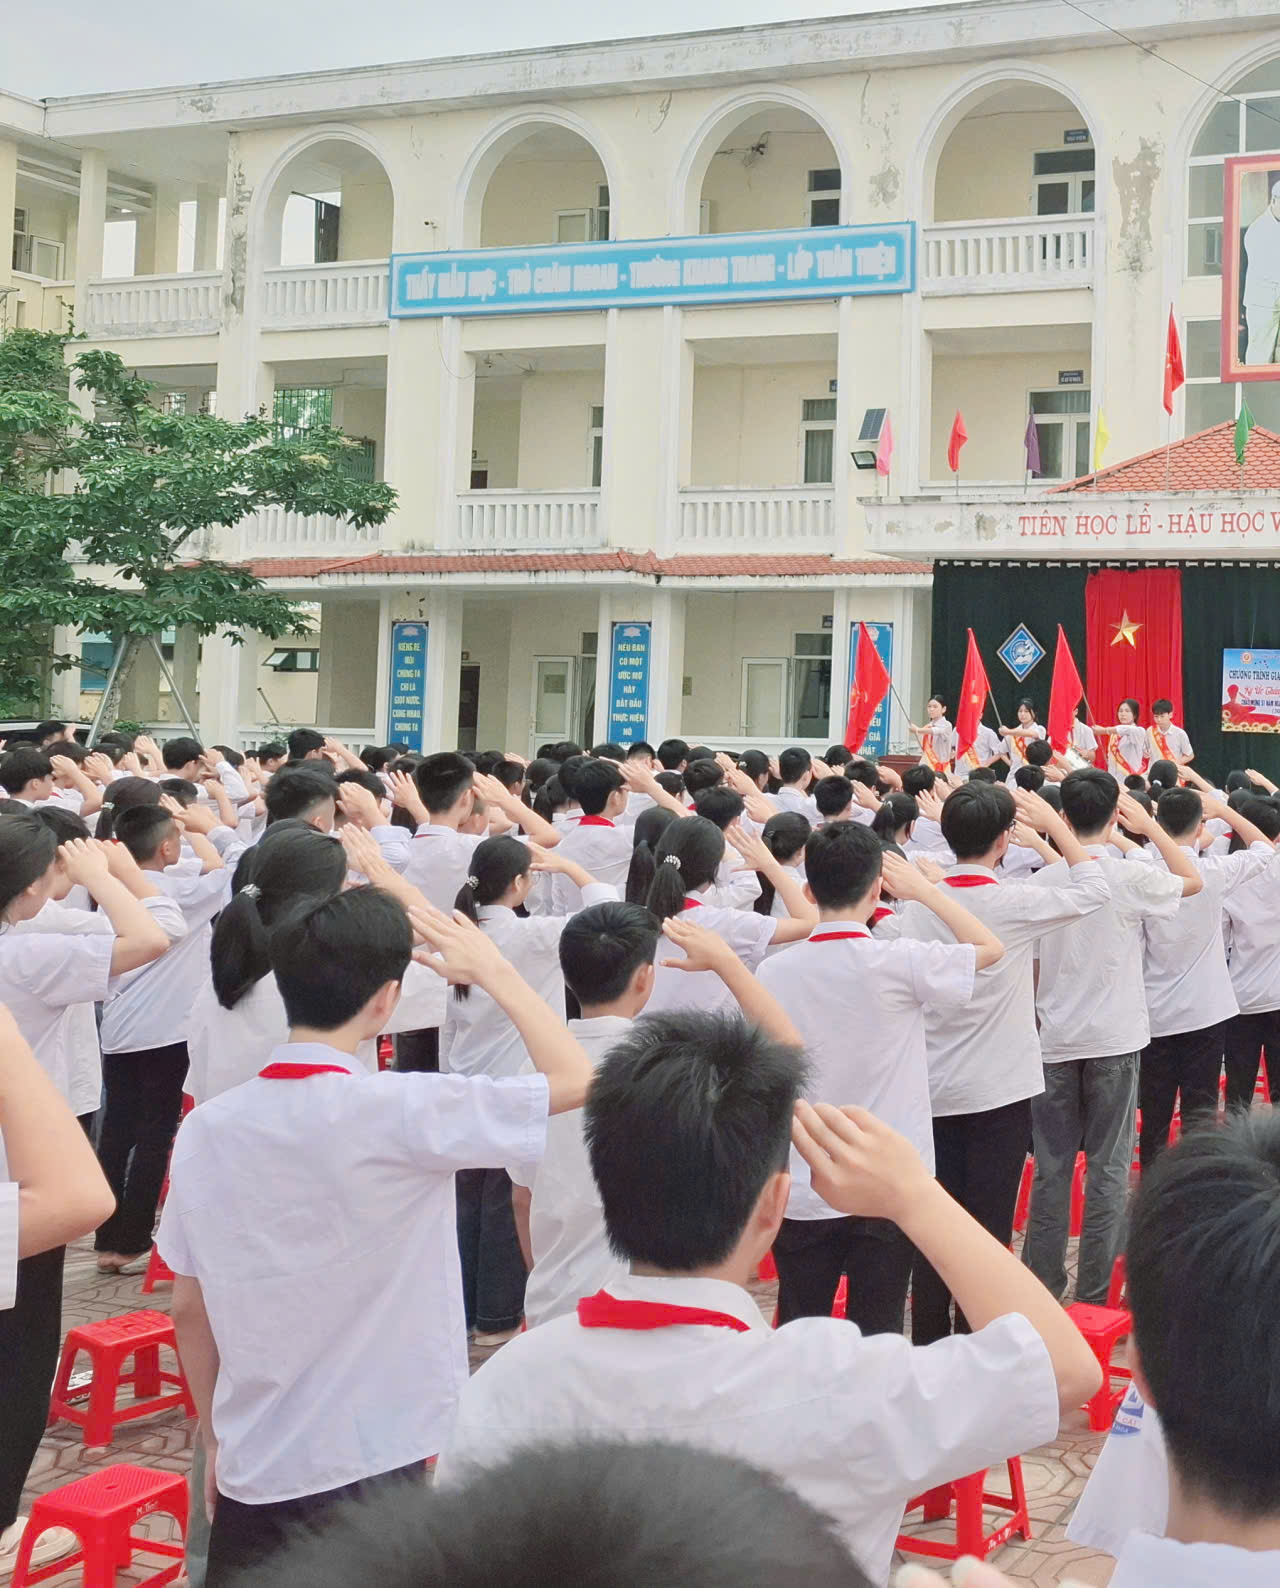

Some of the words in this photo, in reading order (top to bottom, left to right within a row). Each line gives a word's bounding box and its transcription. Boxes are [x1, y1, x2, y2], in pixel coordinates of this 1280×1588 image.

[1018, 509, 1067, 537] TIÊN
[1074, 514, 1118, 541] HỌC
[1125, 502, 1152, 536] LỄ
[1167, 507, 1213, 539] HẬU
[1220, 512, 1265, 538] HỌC
